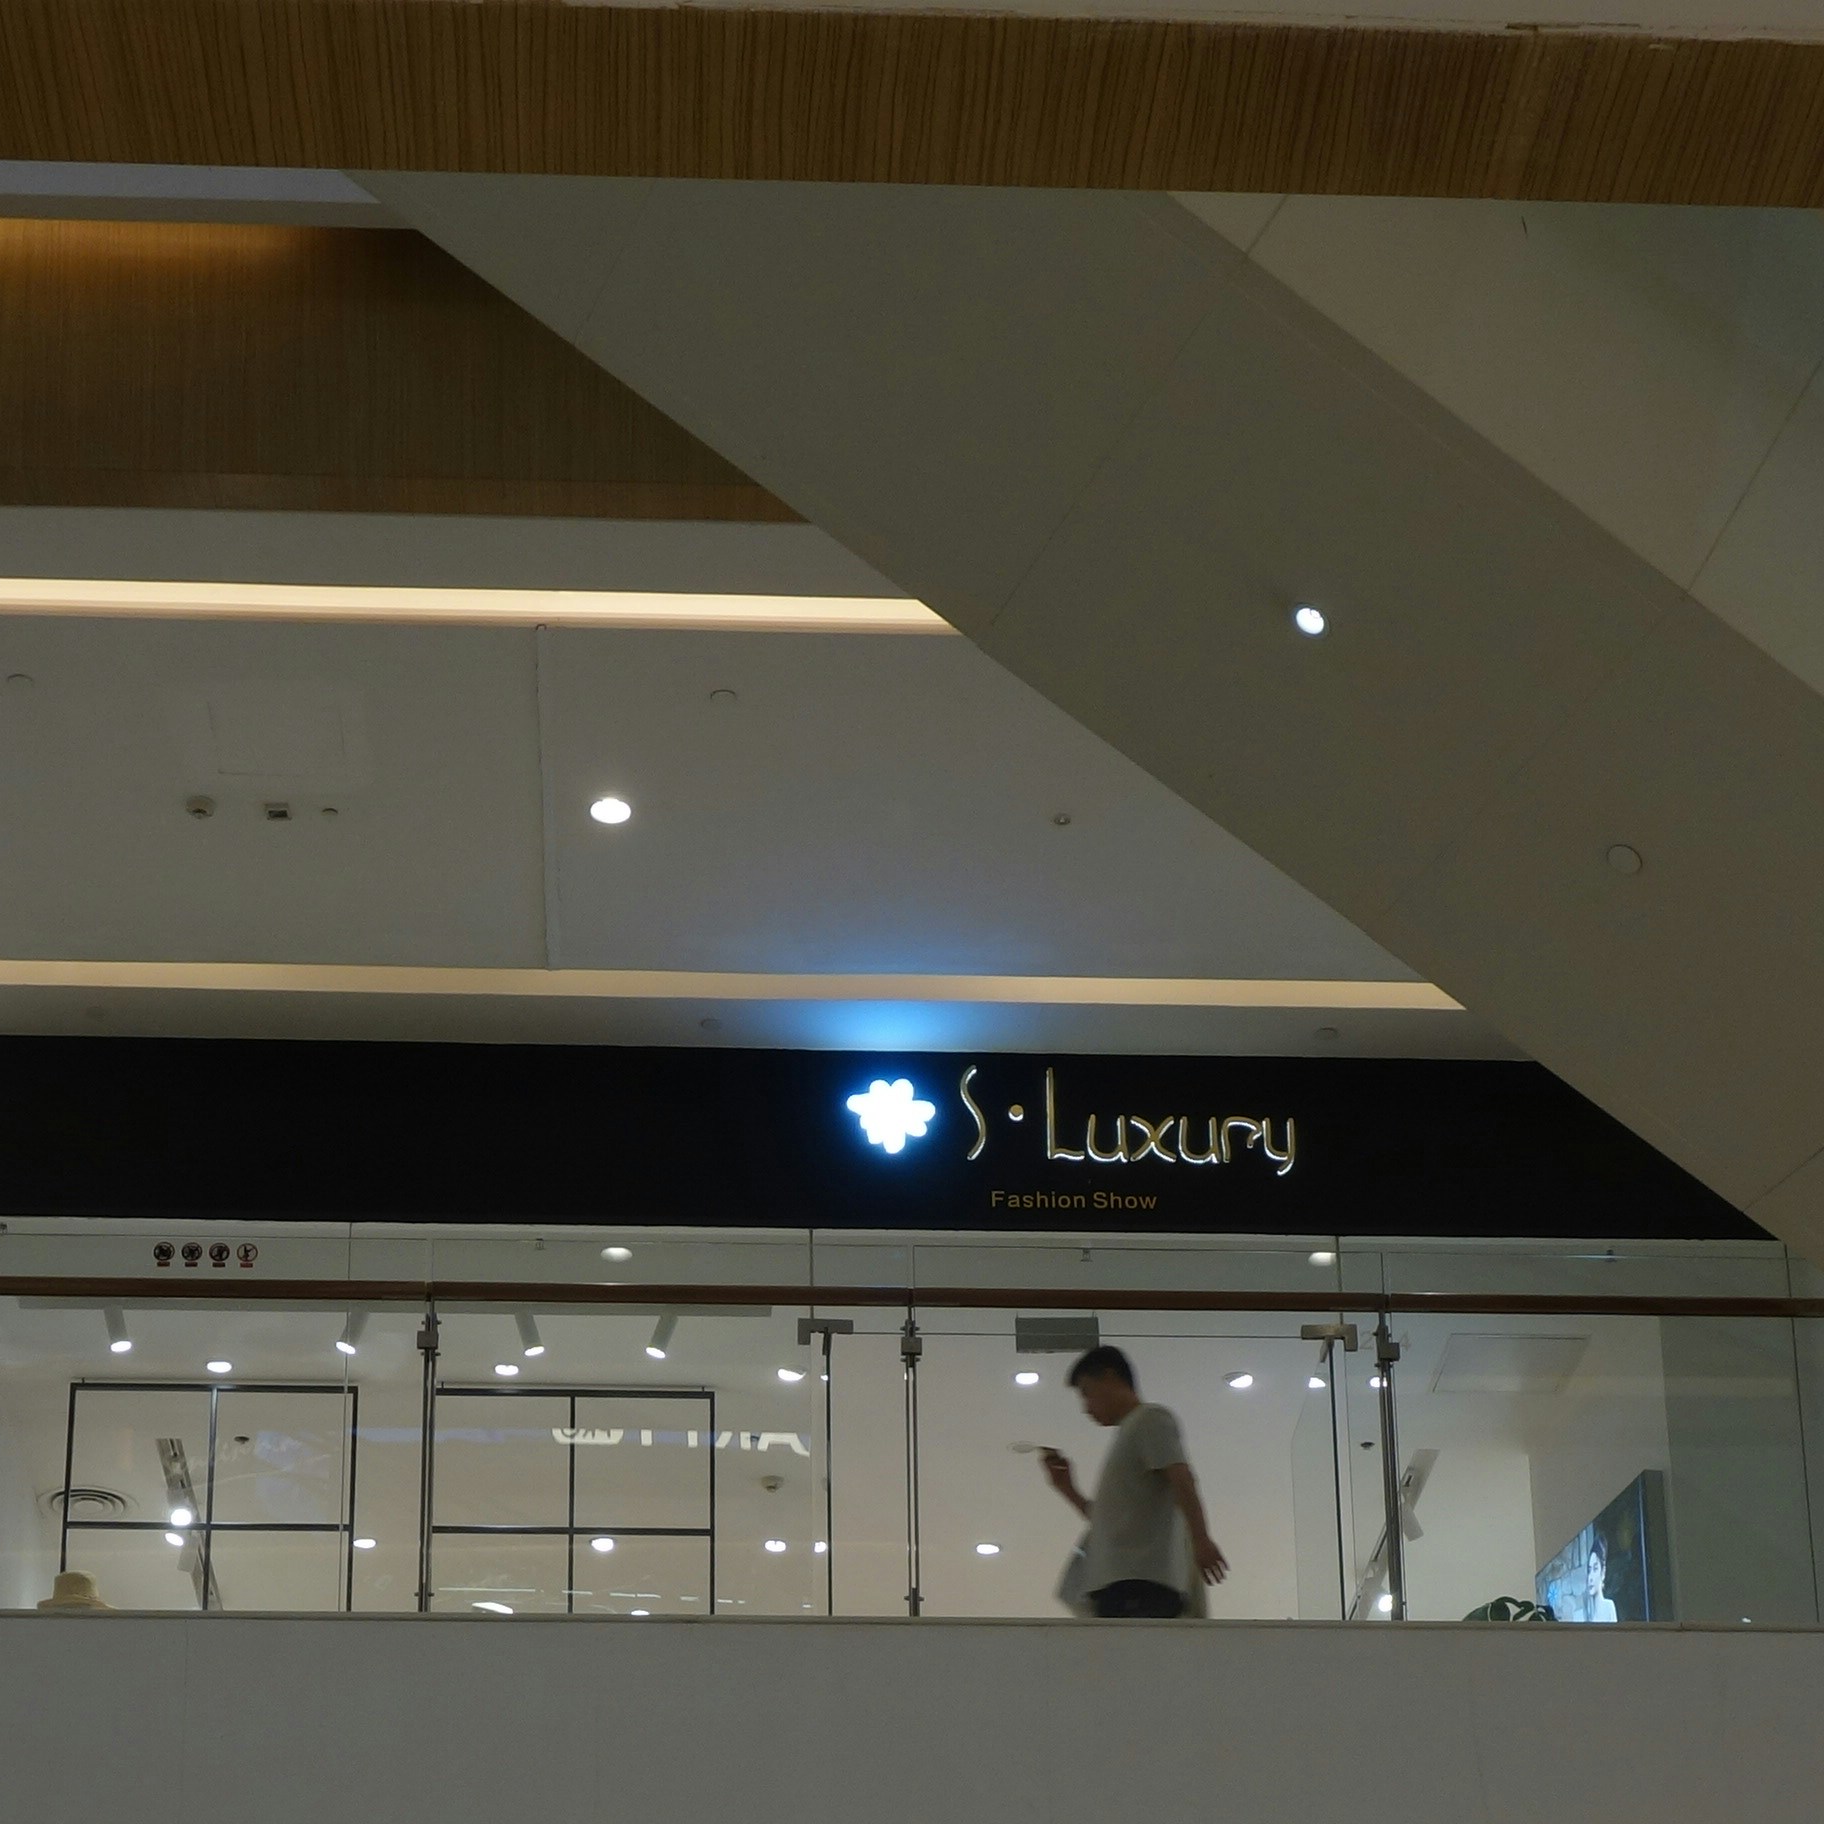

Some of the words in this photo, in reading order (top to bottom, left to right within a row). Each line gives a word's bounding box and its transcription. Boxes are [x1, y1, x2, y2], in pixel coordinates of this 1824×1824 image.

[991, 1189, 1087, 1211] Fashion
[1092, 1190, 1157, 1211] Show
[1360, 1330, 1410, 1350] 24
